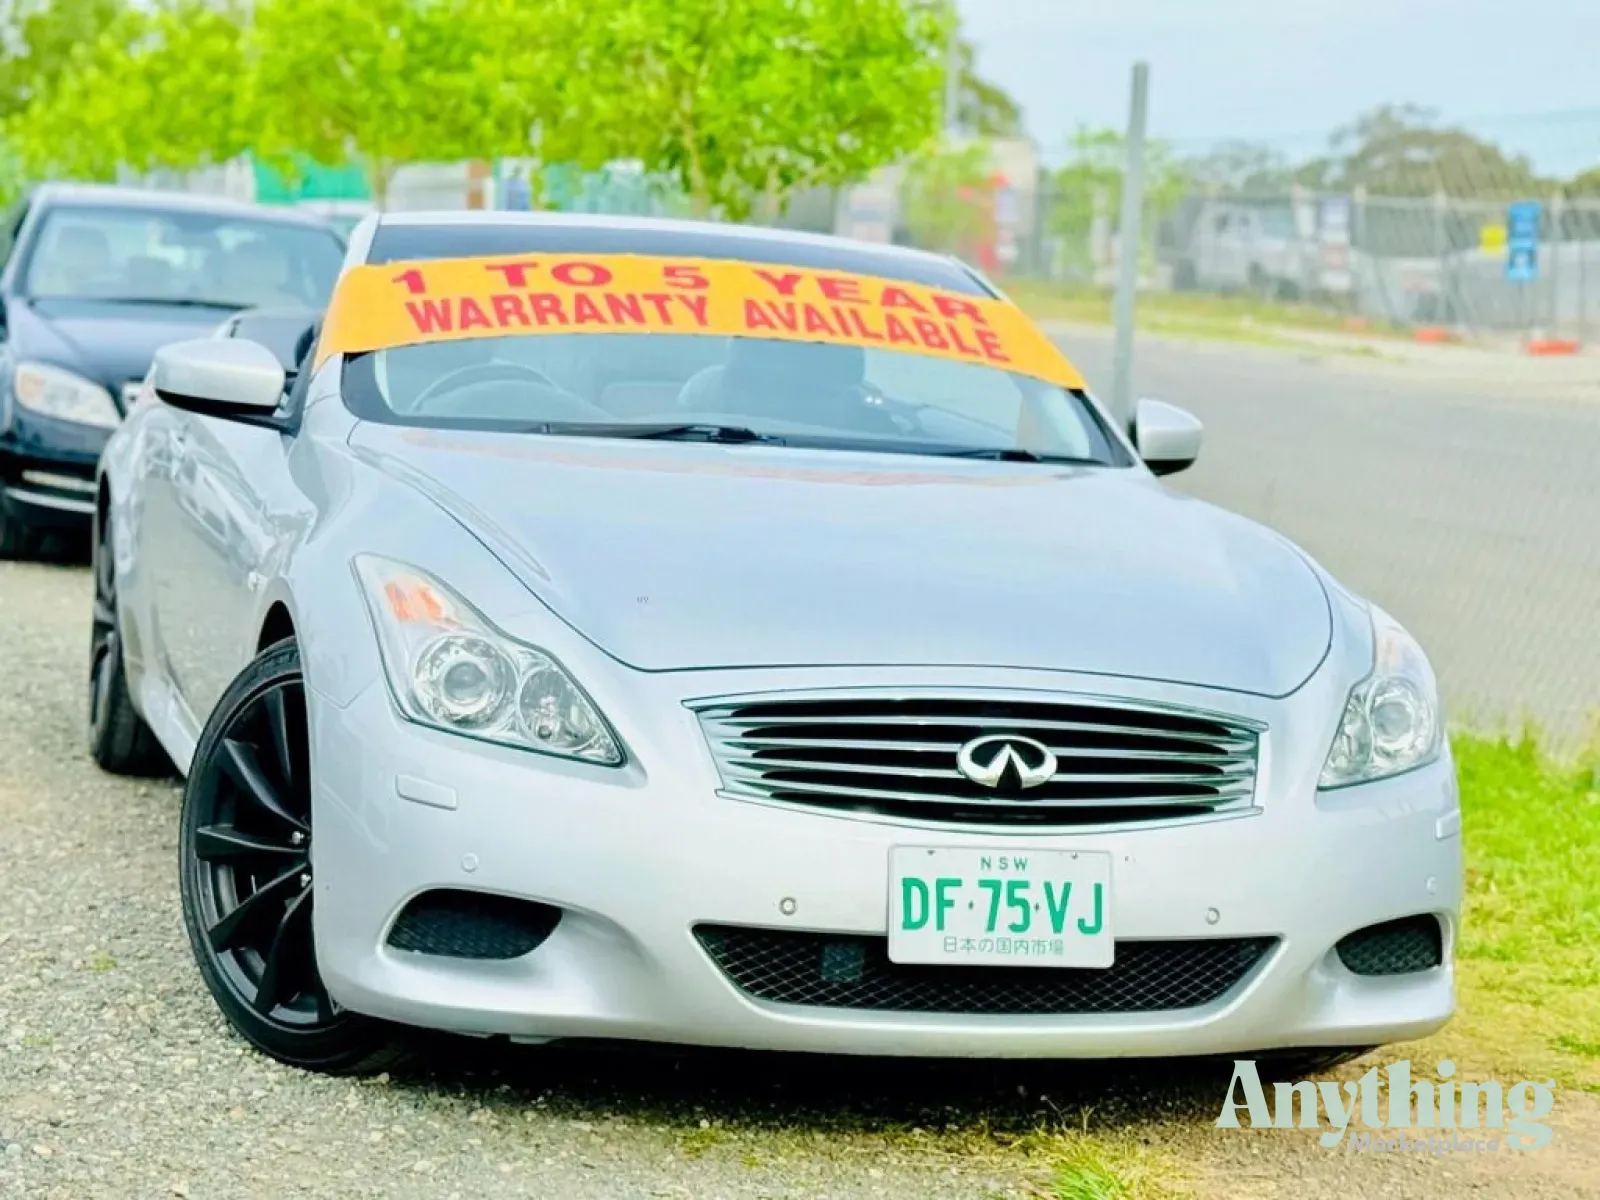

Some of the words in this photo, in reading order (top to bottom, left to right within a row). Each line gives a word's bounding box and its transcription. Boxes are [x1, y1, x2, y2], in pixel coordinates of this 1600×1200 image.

[393, 269, 426, 293] 1
[486, 262, 613, 287] TO
[664, 265, 710, 289] 5
[755, 270, 989, 324] YEAR
[404, 293, 709, 334] WARRANTY
[744, 298, 1011, 364] AVAILABLE
[980, 856, 1029, 871] NSW
